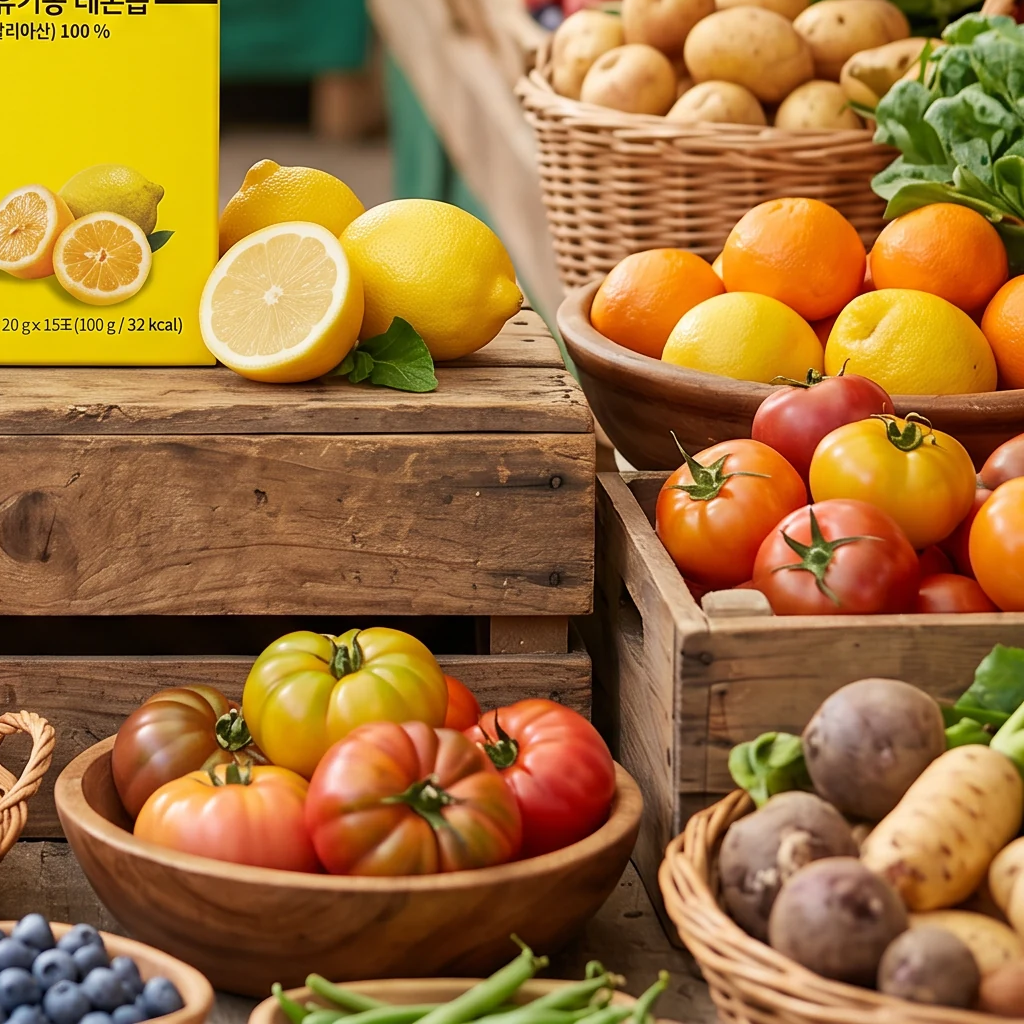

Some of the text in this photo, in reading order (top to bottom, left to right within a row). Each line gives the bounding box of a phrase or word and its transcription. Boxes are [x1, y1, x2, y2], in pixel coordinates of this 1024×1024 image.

[60, 23, 90, 39] 100
[93, 23, 110, 39] %
[2, 318, 19, 332] 20
[127, 318, 145, 332] 32
[149, 317, 183, 335] kcal)
